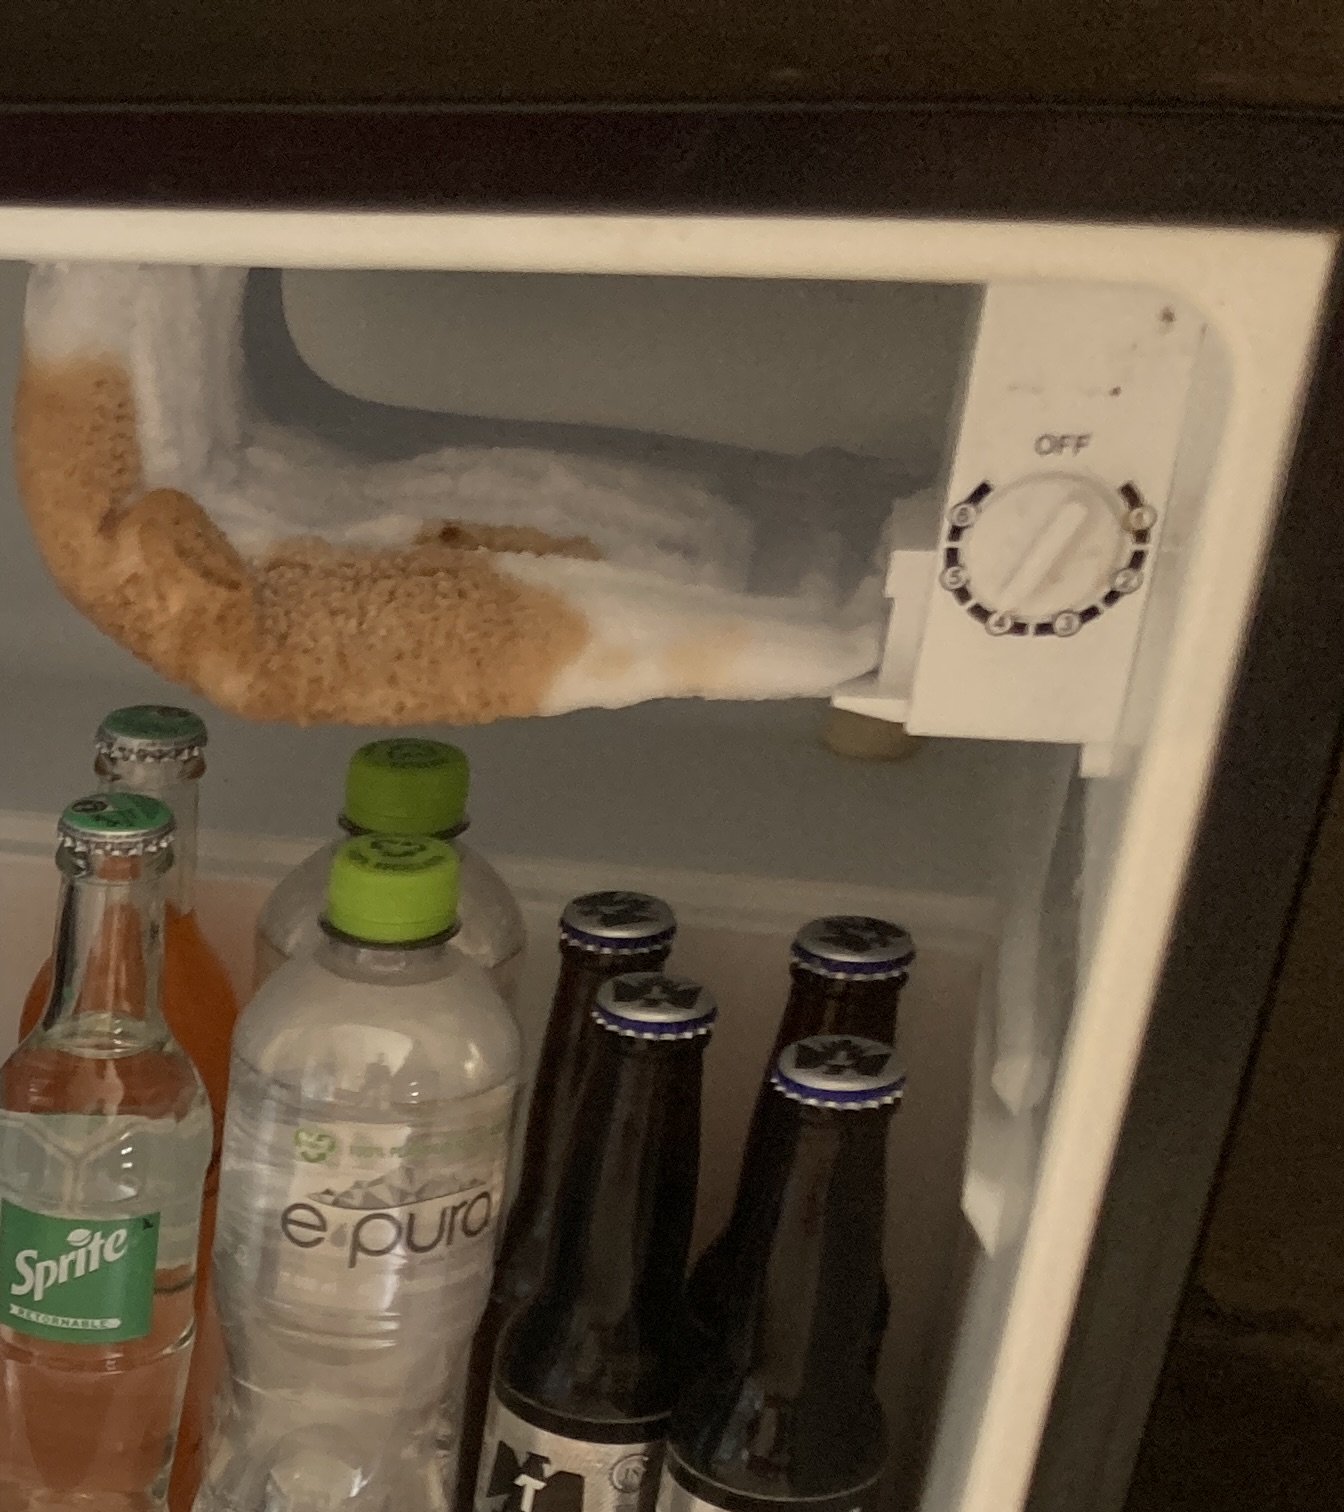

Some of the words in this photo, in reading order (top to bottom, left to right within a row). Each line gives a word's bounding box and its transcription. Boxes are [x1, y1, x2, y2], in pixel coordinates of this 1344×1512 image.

[1034, 433, 1092, 457] OFF
[9, 1227, 129, 1302] Sprite
[16, 1307, 110, 1330] RETORNABLE
